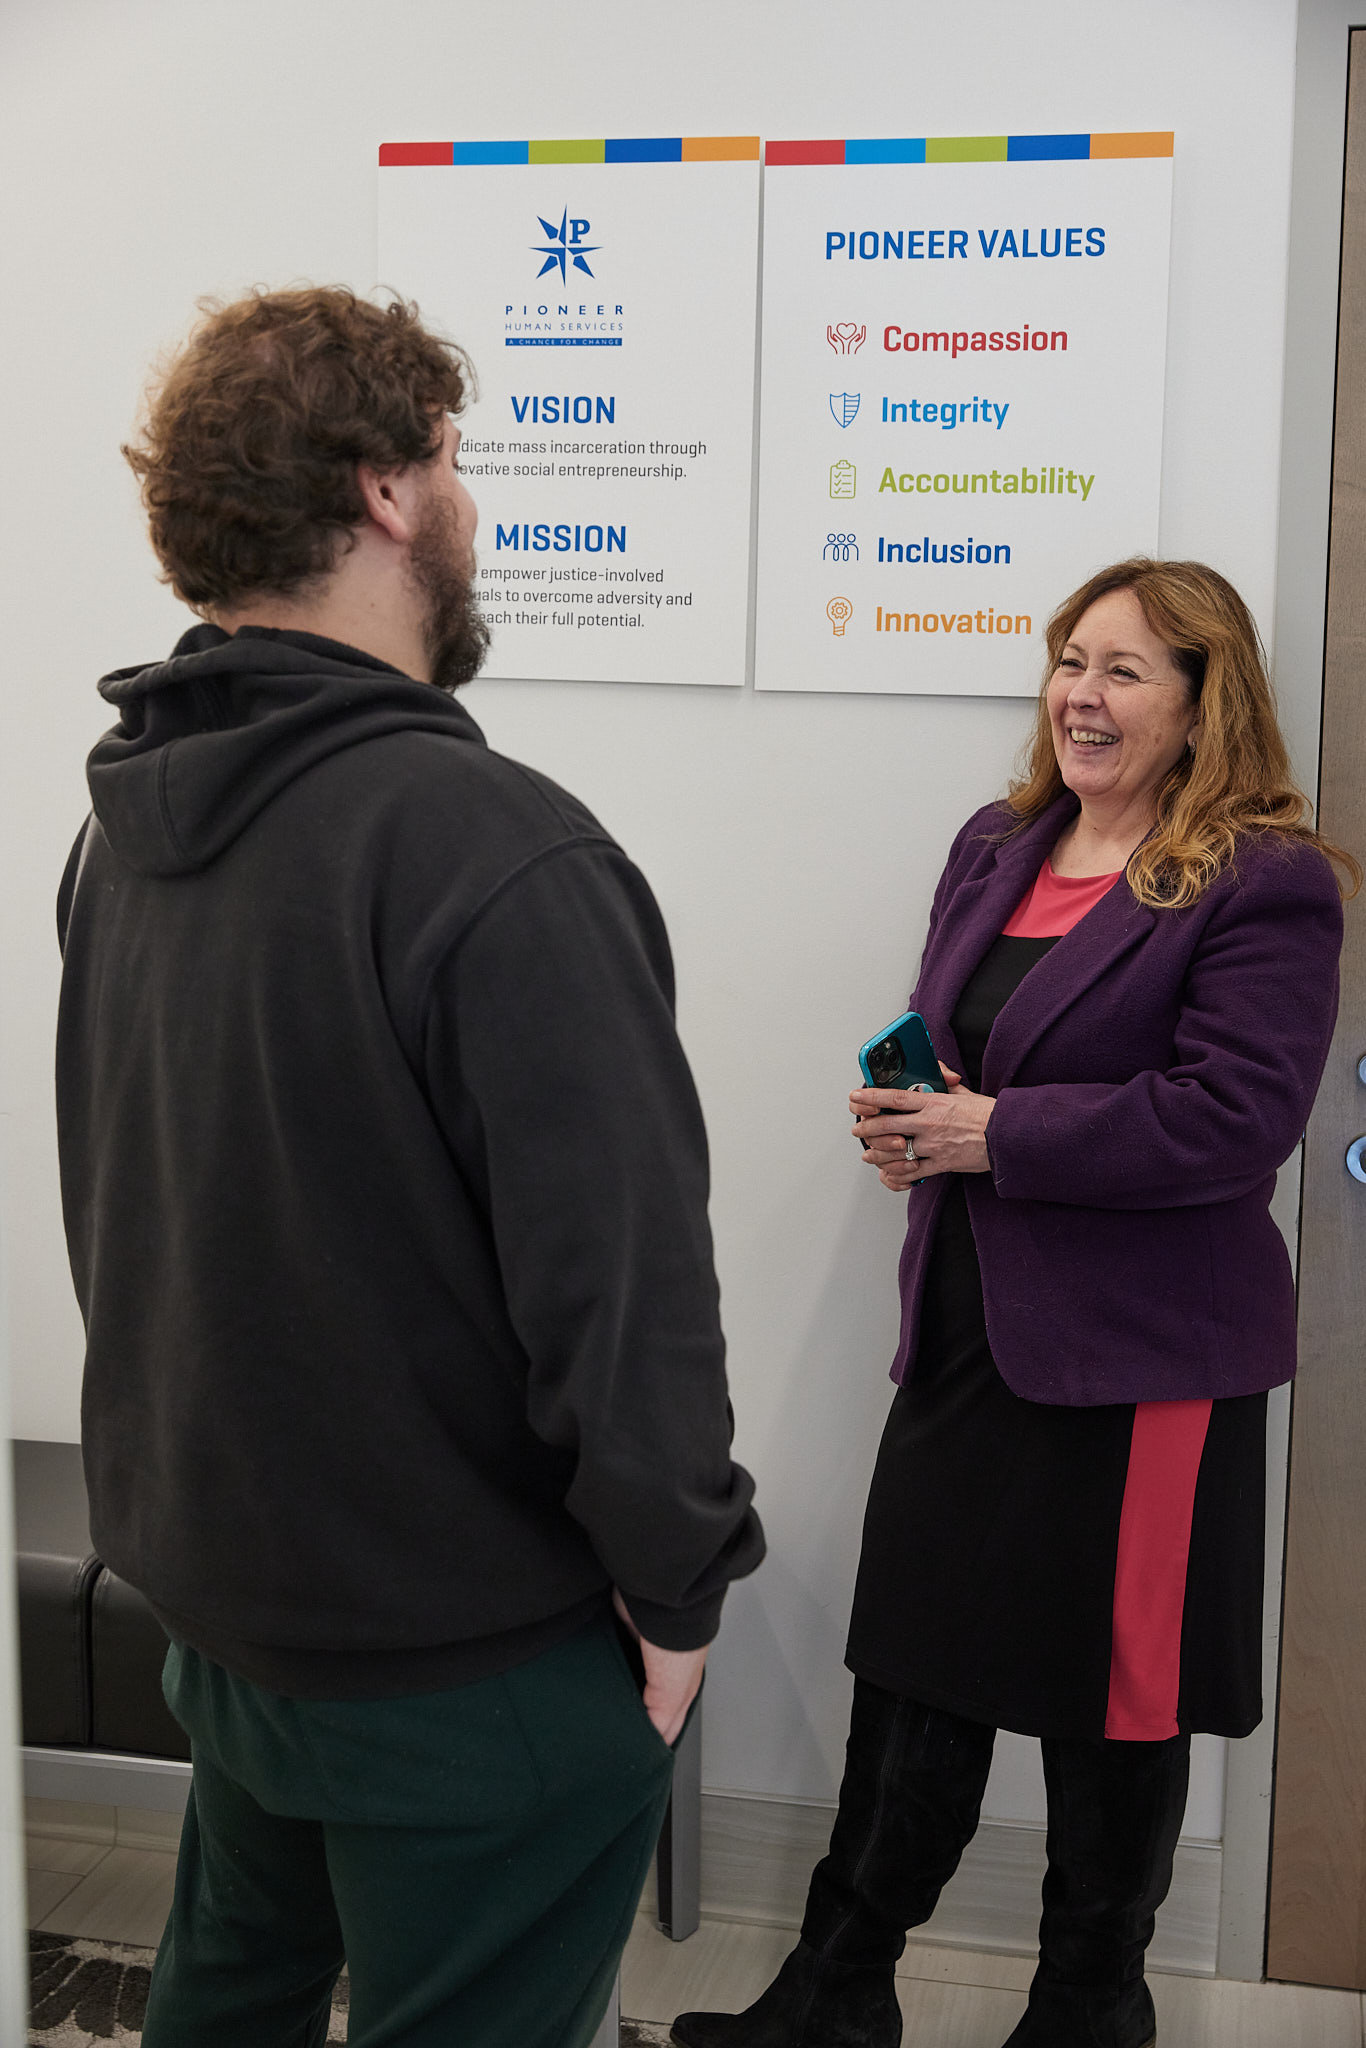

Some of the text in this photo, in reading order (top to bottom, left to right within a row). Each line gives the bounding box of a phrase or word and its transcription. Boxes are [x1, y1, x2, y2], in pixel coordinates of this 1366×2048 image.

[569, 219, 590, 244] P
[826, 228, 1105, 260] PIONEER VALUES
[506, 305, 622, 315] PIONEER
[505, 323, 623, 331] HUMAN SERVICES
[884, 324, 1067, 358] Compassion
[511, 396, 615, 423] VISION
[883, 396, 1009, 429] Integrity
[458, 439, 706, 458] dicate mass incarceration through
[456, 462, 686, 480] ovative social entrepreneurship.
[879, 467, 1095, 501] Accountability
[496, 524, 626, 552] MISSION
[879, 537, 1010, 564] Inclusion
[481, 567, 663, 583] empower justice-involved
[474, 588, 692, 608] uals to overcome adversity and
[479, 611, 644, 628] each their full potential.
[877, 607, 1031, 634] Innovation
